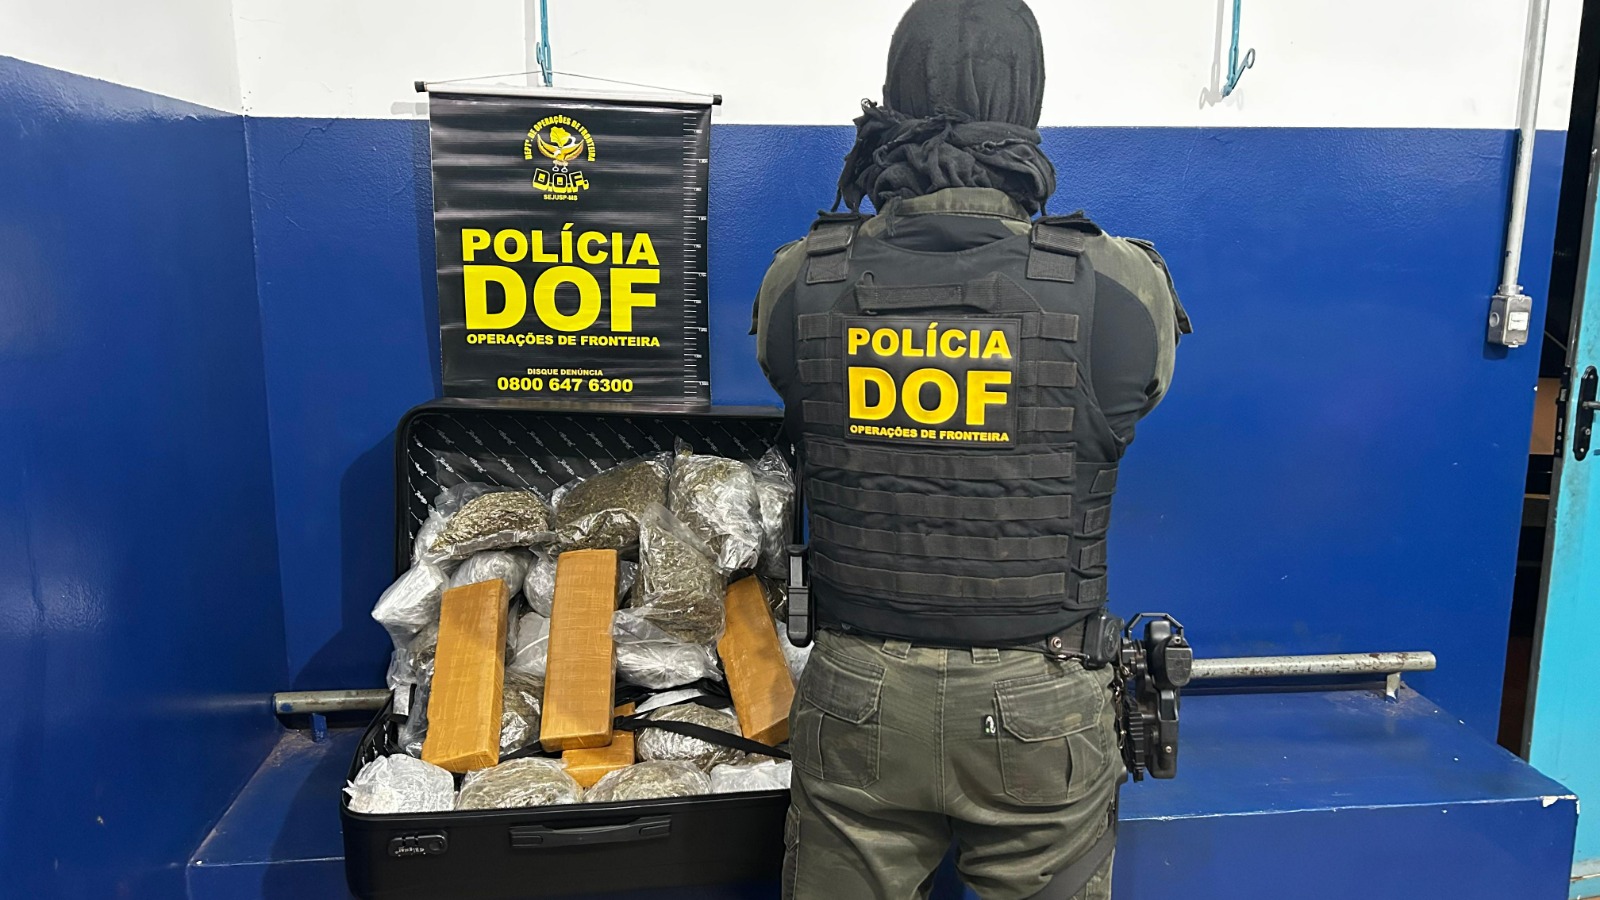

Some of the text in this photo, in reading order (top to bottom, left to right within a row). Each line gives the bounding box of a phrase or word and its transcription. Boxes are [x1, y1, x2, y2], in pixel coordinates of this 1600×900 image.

[533, 114, 571, 132] OPERAÇÕES
[570, 119, 581, 130] DE
[578, 126, 596, 162] FRONTEIRA
[461, 222, 660, 266] POLÍCIA
[463, 265, 660, 333] DOF
[466, 332, 660, 347] OPERAÇÕES DE FRONTEIRA
[848, 322, 1012, 359] POLÍCIA
[497, 377, 633, 393] 0800 647 6300
[527, 368, 604, 376] DISQUE DENÚNCIA
[848, 366, 1012, 426] DOF
[850, 424, 1010, 442] OPERAÇÕES DE FRONTEIRA
